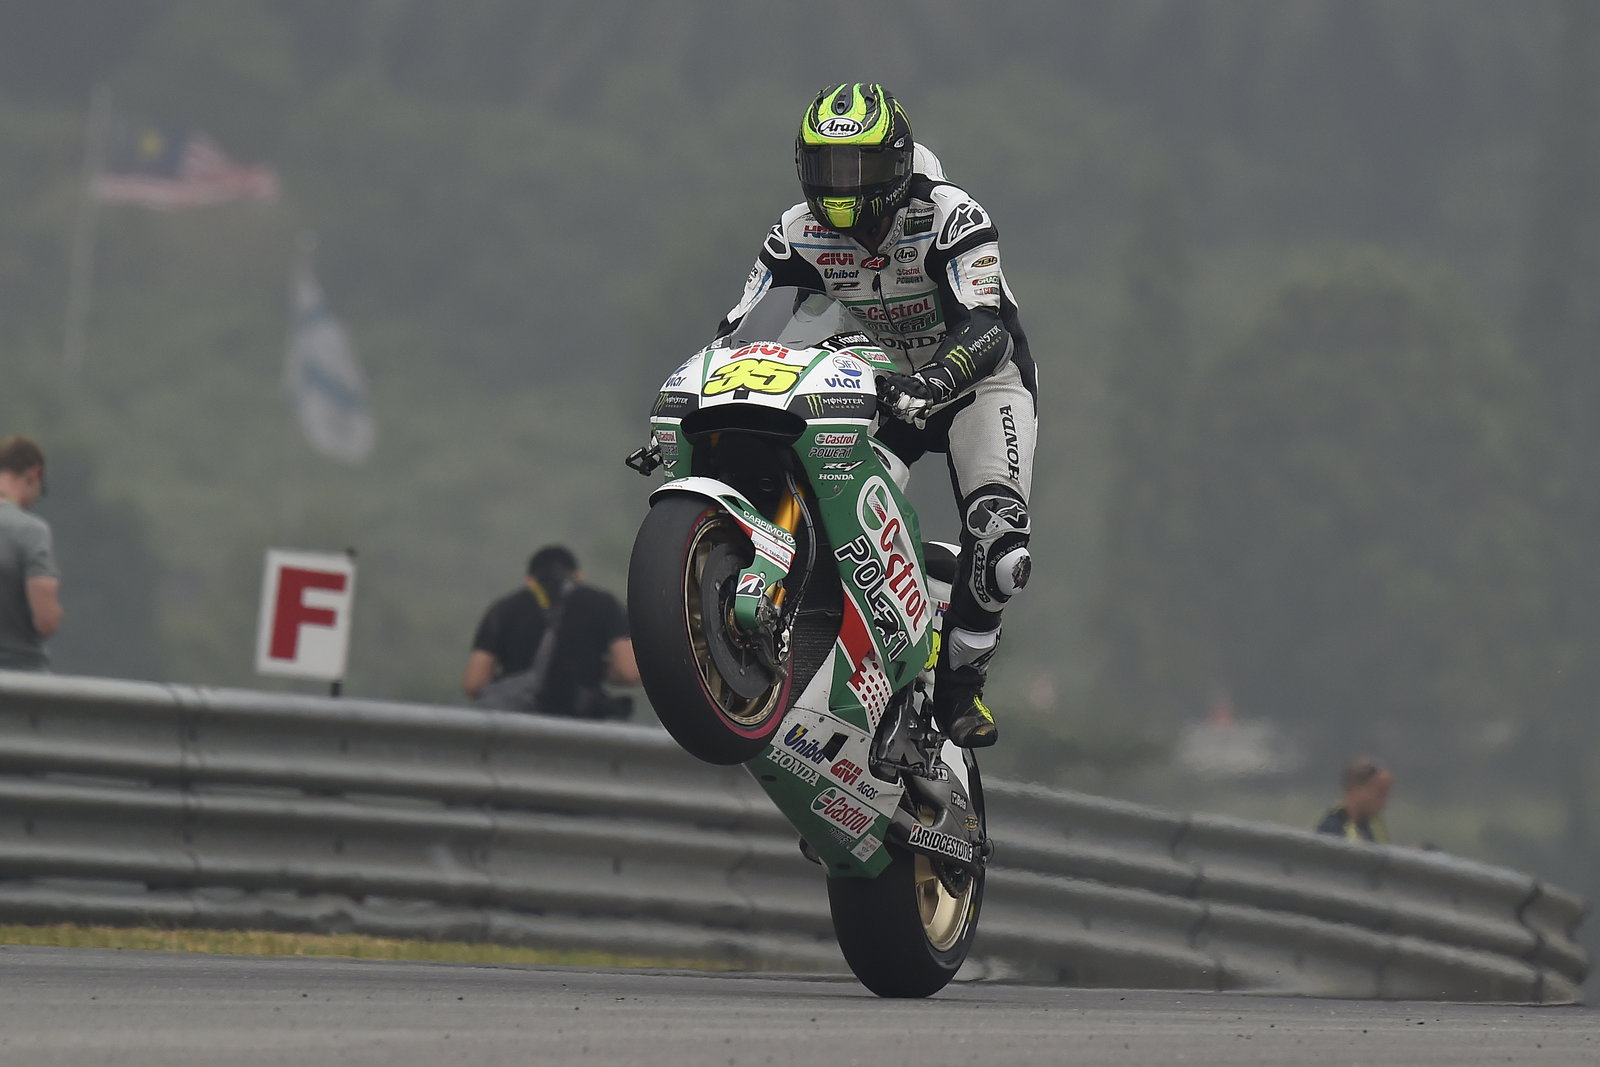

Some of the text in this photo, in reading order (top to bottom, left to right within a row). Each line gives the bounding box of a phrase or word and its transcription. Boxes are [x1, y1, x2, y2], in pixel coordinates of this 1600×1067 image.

[821, 120, 857, 132] Arai
[816, 252, 856, 265] GIVI
[896, 248, 916, 259] Arai
[824, 268, 860, 279] Unibat
[901, 267, 921, 275] Castrol
[867, 298, 932, 321] Castrol
[875, 332, 947, 350] ONDA
[968, 325, 1002, 353] MONSTER
[730, 344, 789, 359] GIVI
[701, 358, 806, 397] 35
[825, 374, 861, 389] viar
[822, 396, 864, 406] MONSTER
[825, 434, 855, 444] Castrol
[999, 404, 1021, 482] HONDA
[808, 447, 853, 458] POWER1
[818, 473, 855, 481] HONDA
[743, 510, 795, 546] CARPIMOTO
[880, 518, 927, 632] Cstrol
[269, 566, 347, 660] F
[766, 748, 820, 787] HONDA
[830, 758, 864, 786] GIVI
[856, 781, 879, 800] AGOS
[823, 796, 874, 835] Castrol
[908, 823, 974, 862] BRIDGESTONE
